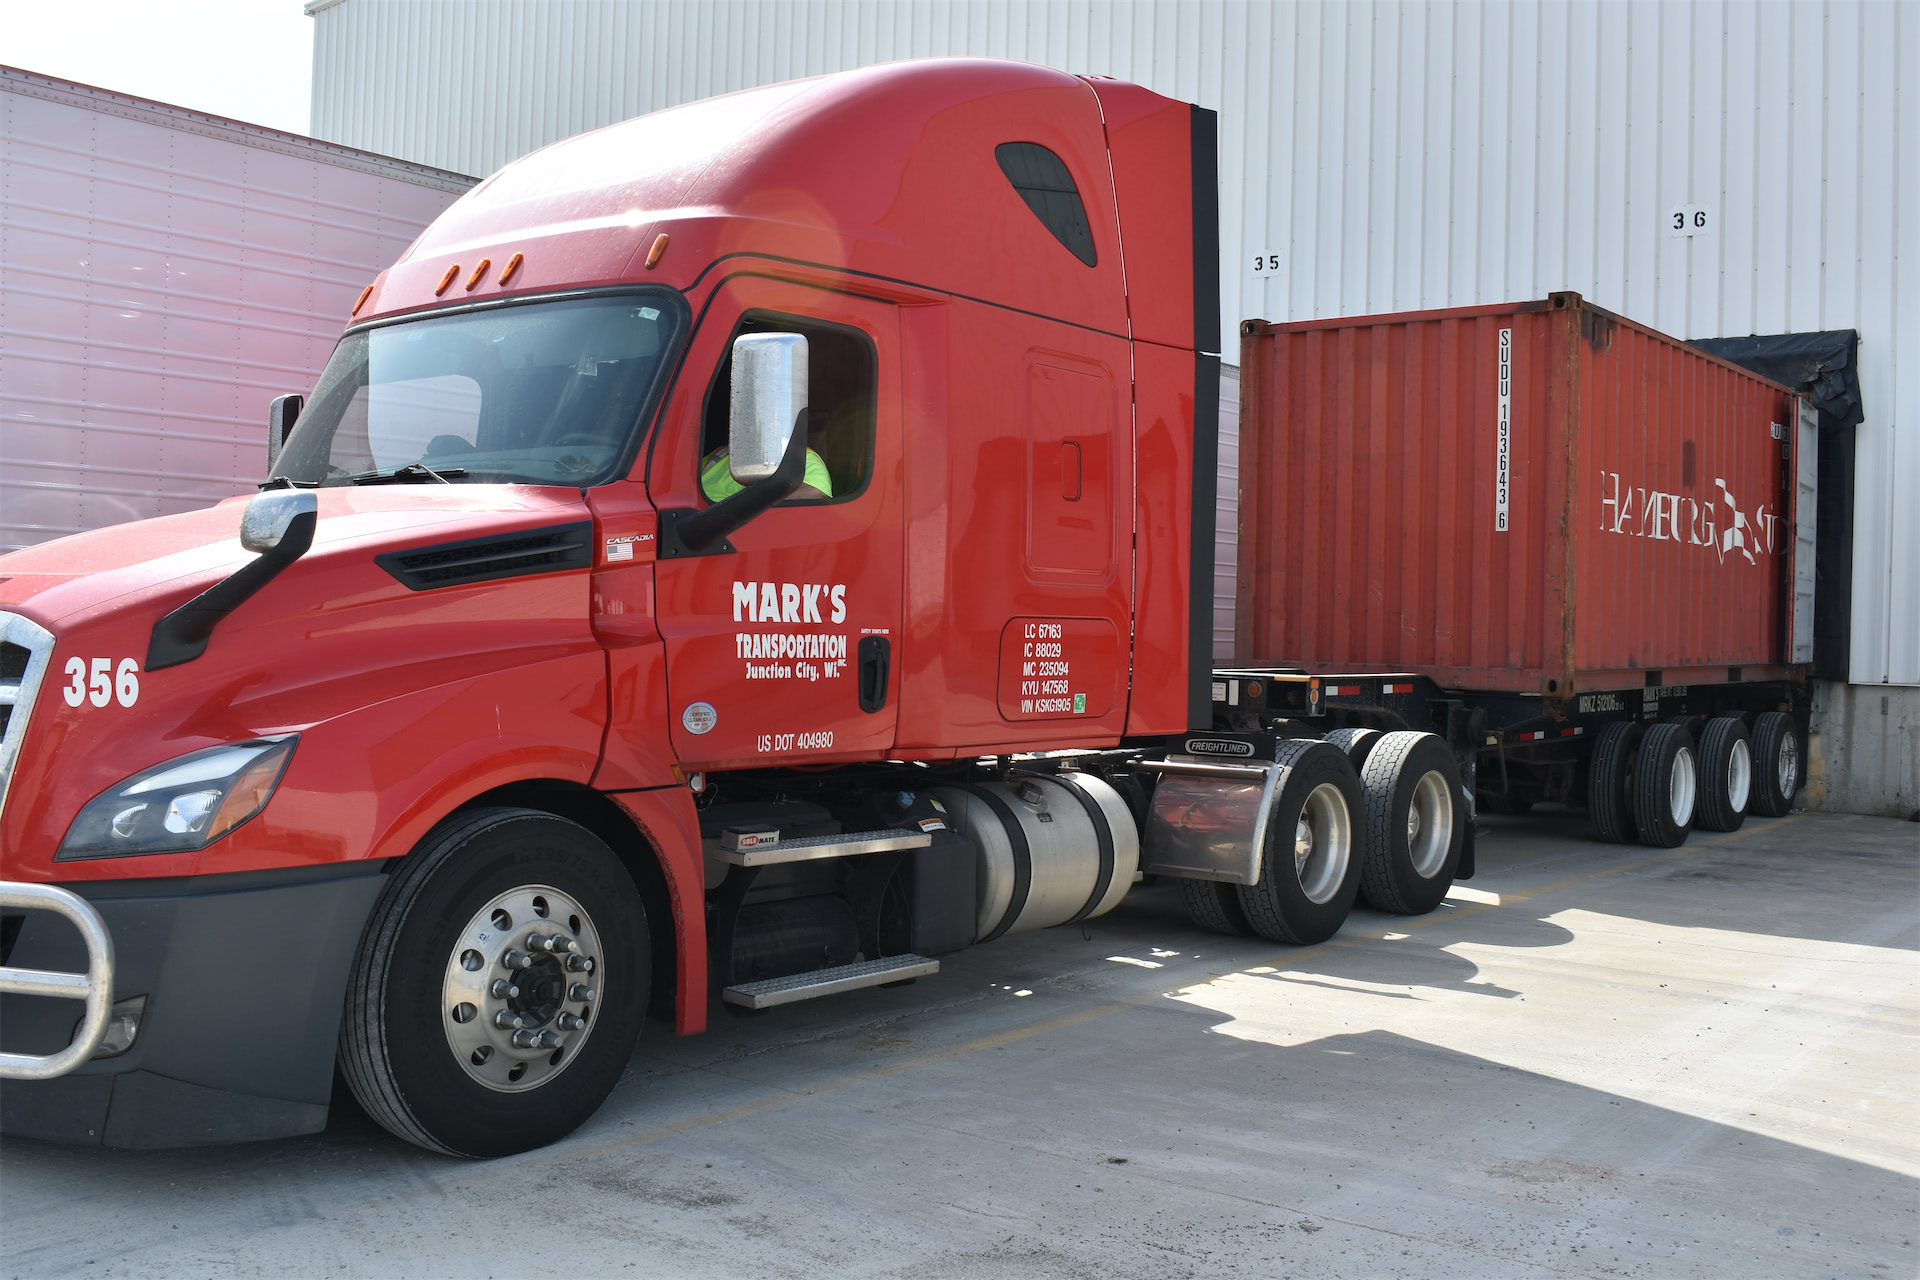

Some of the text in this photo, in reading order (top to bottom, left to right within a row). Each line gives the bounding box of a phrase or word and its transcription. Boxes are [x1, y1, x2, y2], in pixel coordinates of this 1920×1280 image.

[1500, 330, 1509, 396] SUDU
[1499, 403, 1507, 504] 193643
[606, 534, 654, 545] CASCADIA
[732, 581, 846, 625] MARK'S
[1024, 623, 1062, 639] LC 67163
[736, 633, 847, 659] TRANSPORTATION
[1023, 642, 1061, 658] IC 88029
[746, 661, 840, 682] Junction City, Wi.
[1023, 661, 1069, 676] MC 235094
[63, 656, 140, 708] 356
[1021, 679, 1068, 695] KYU 147568
[1021, 699, 1033, 713] VIN
[1035, 698, 1071, 713] KSKG1905
[757, 731, 833, 752] US DOT 404980
[1191, 742, 1248, 753] FREIGHTLINER
[742, 837, 757, 845] SOLE
